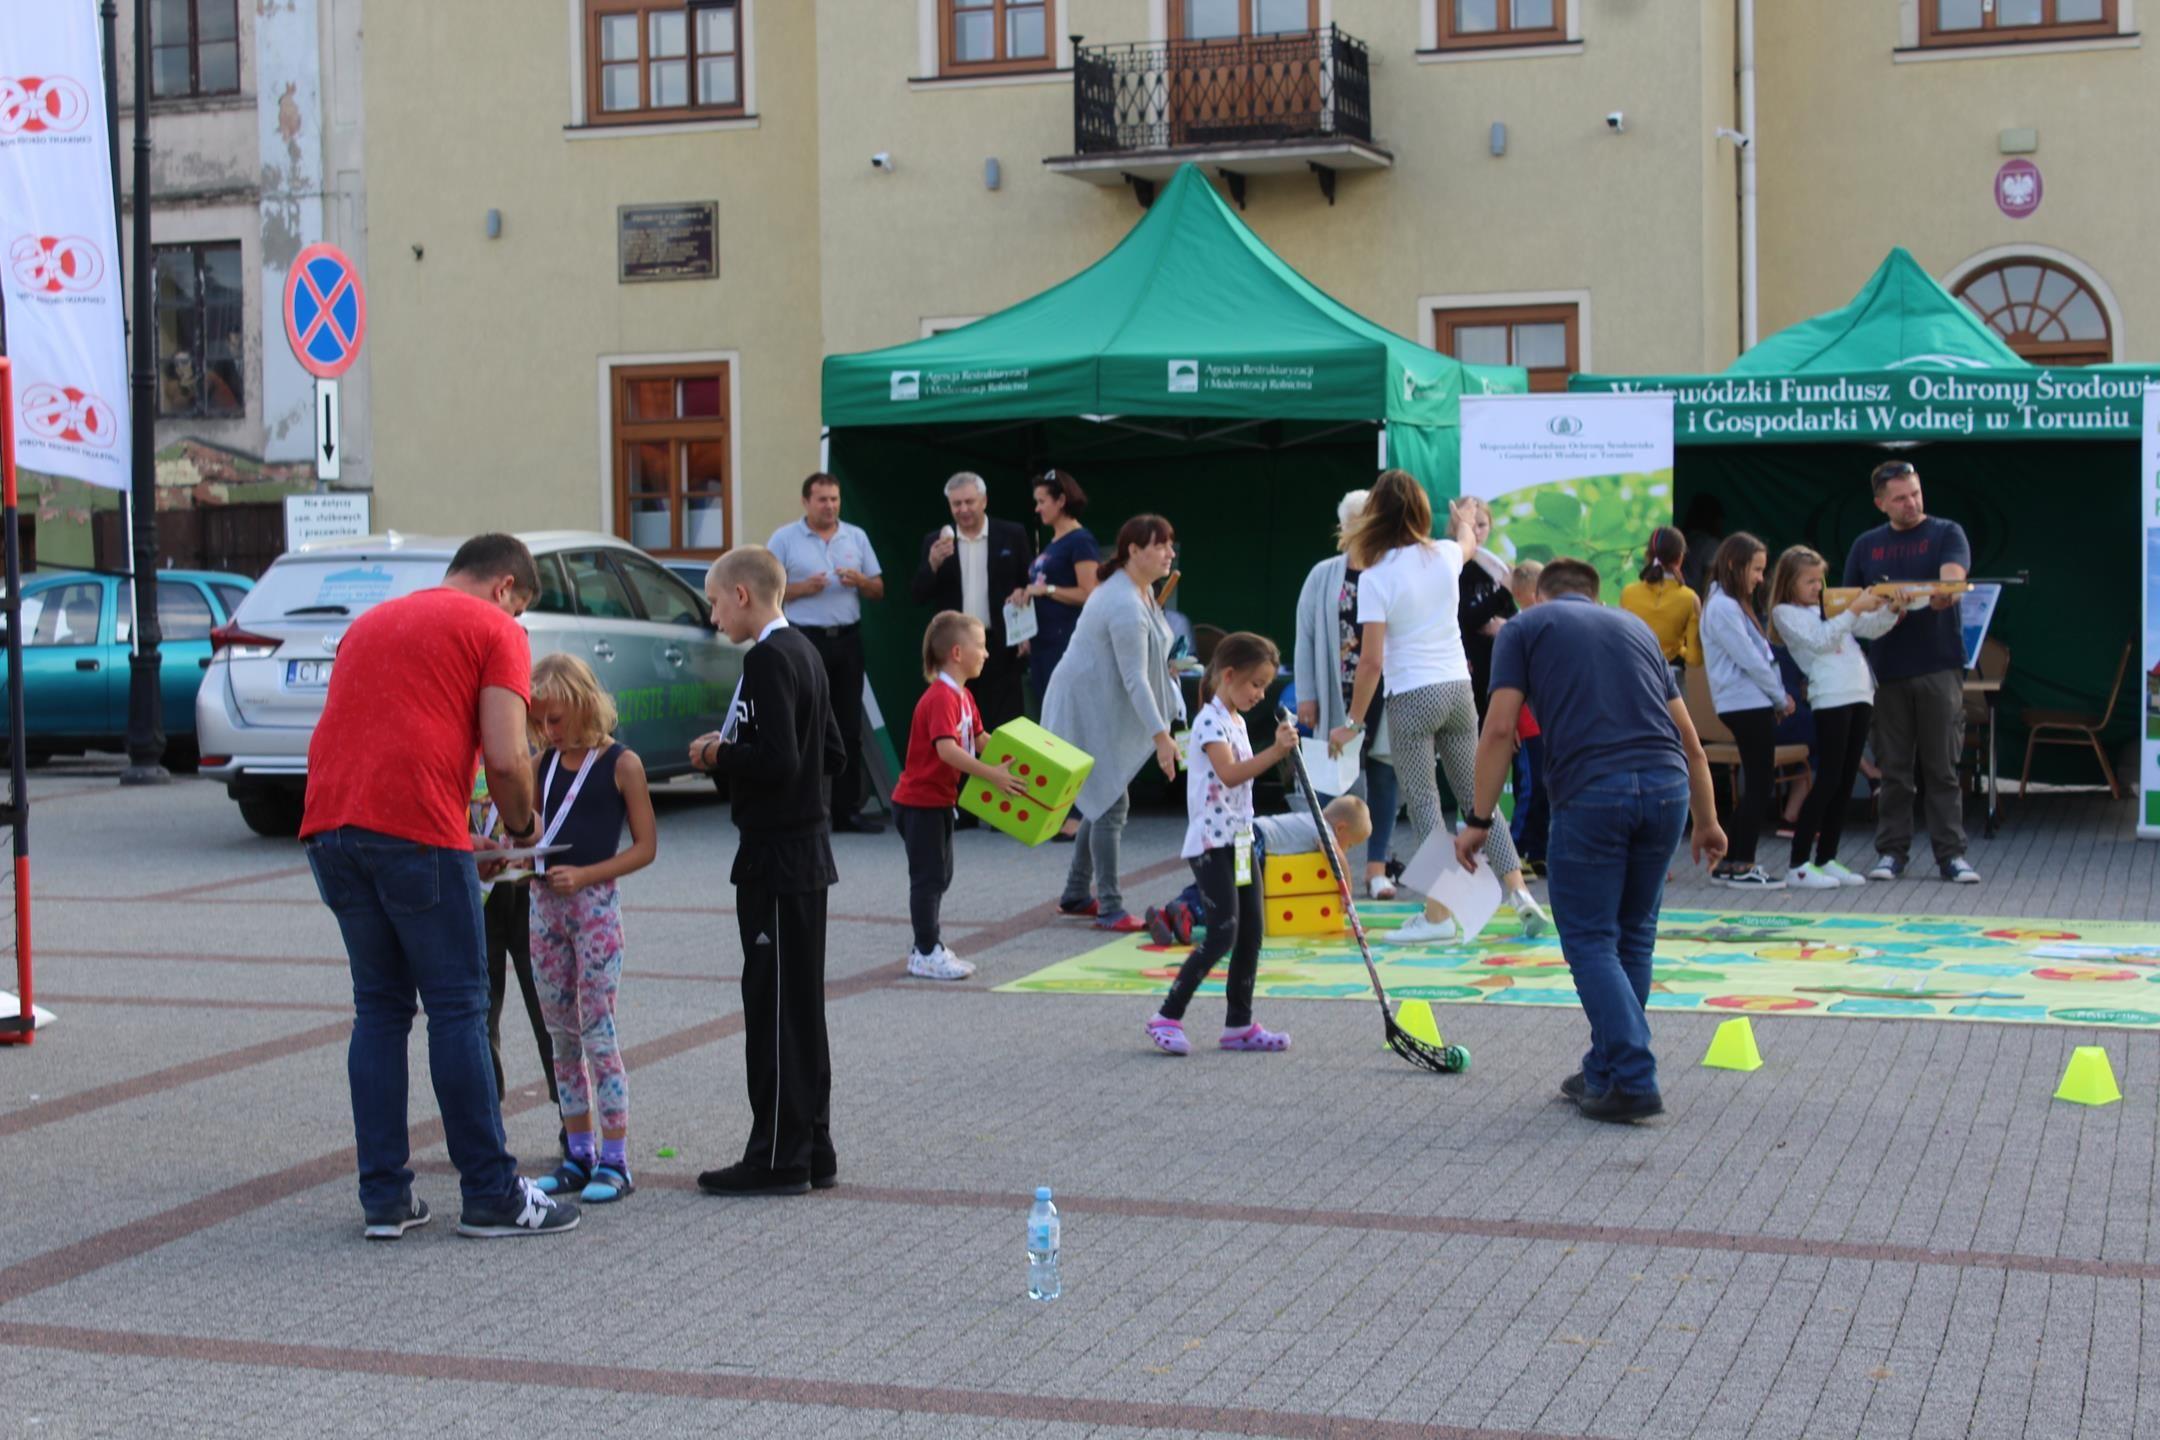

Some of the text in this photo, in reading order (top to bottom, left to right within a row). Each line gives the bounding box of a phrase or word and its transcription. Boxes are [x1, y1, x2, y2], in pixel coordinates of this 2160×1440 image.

[1205, 363, 1240, 377] Agencja
[1780, 377, 1890, 403] Fundusz
[1909, 374, 2030, 407] Ochrony
[1688, 411, 1696, 433] i
[1703, 406, 1857, 438] Gospodarki
[1866, 405, 1974, 434] Wodnej
[1985, 412, 2010, 429] w
[2019, 404, 2130, 429] Toruniu
[304, 499, 318, 508] Nie
